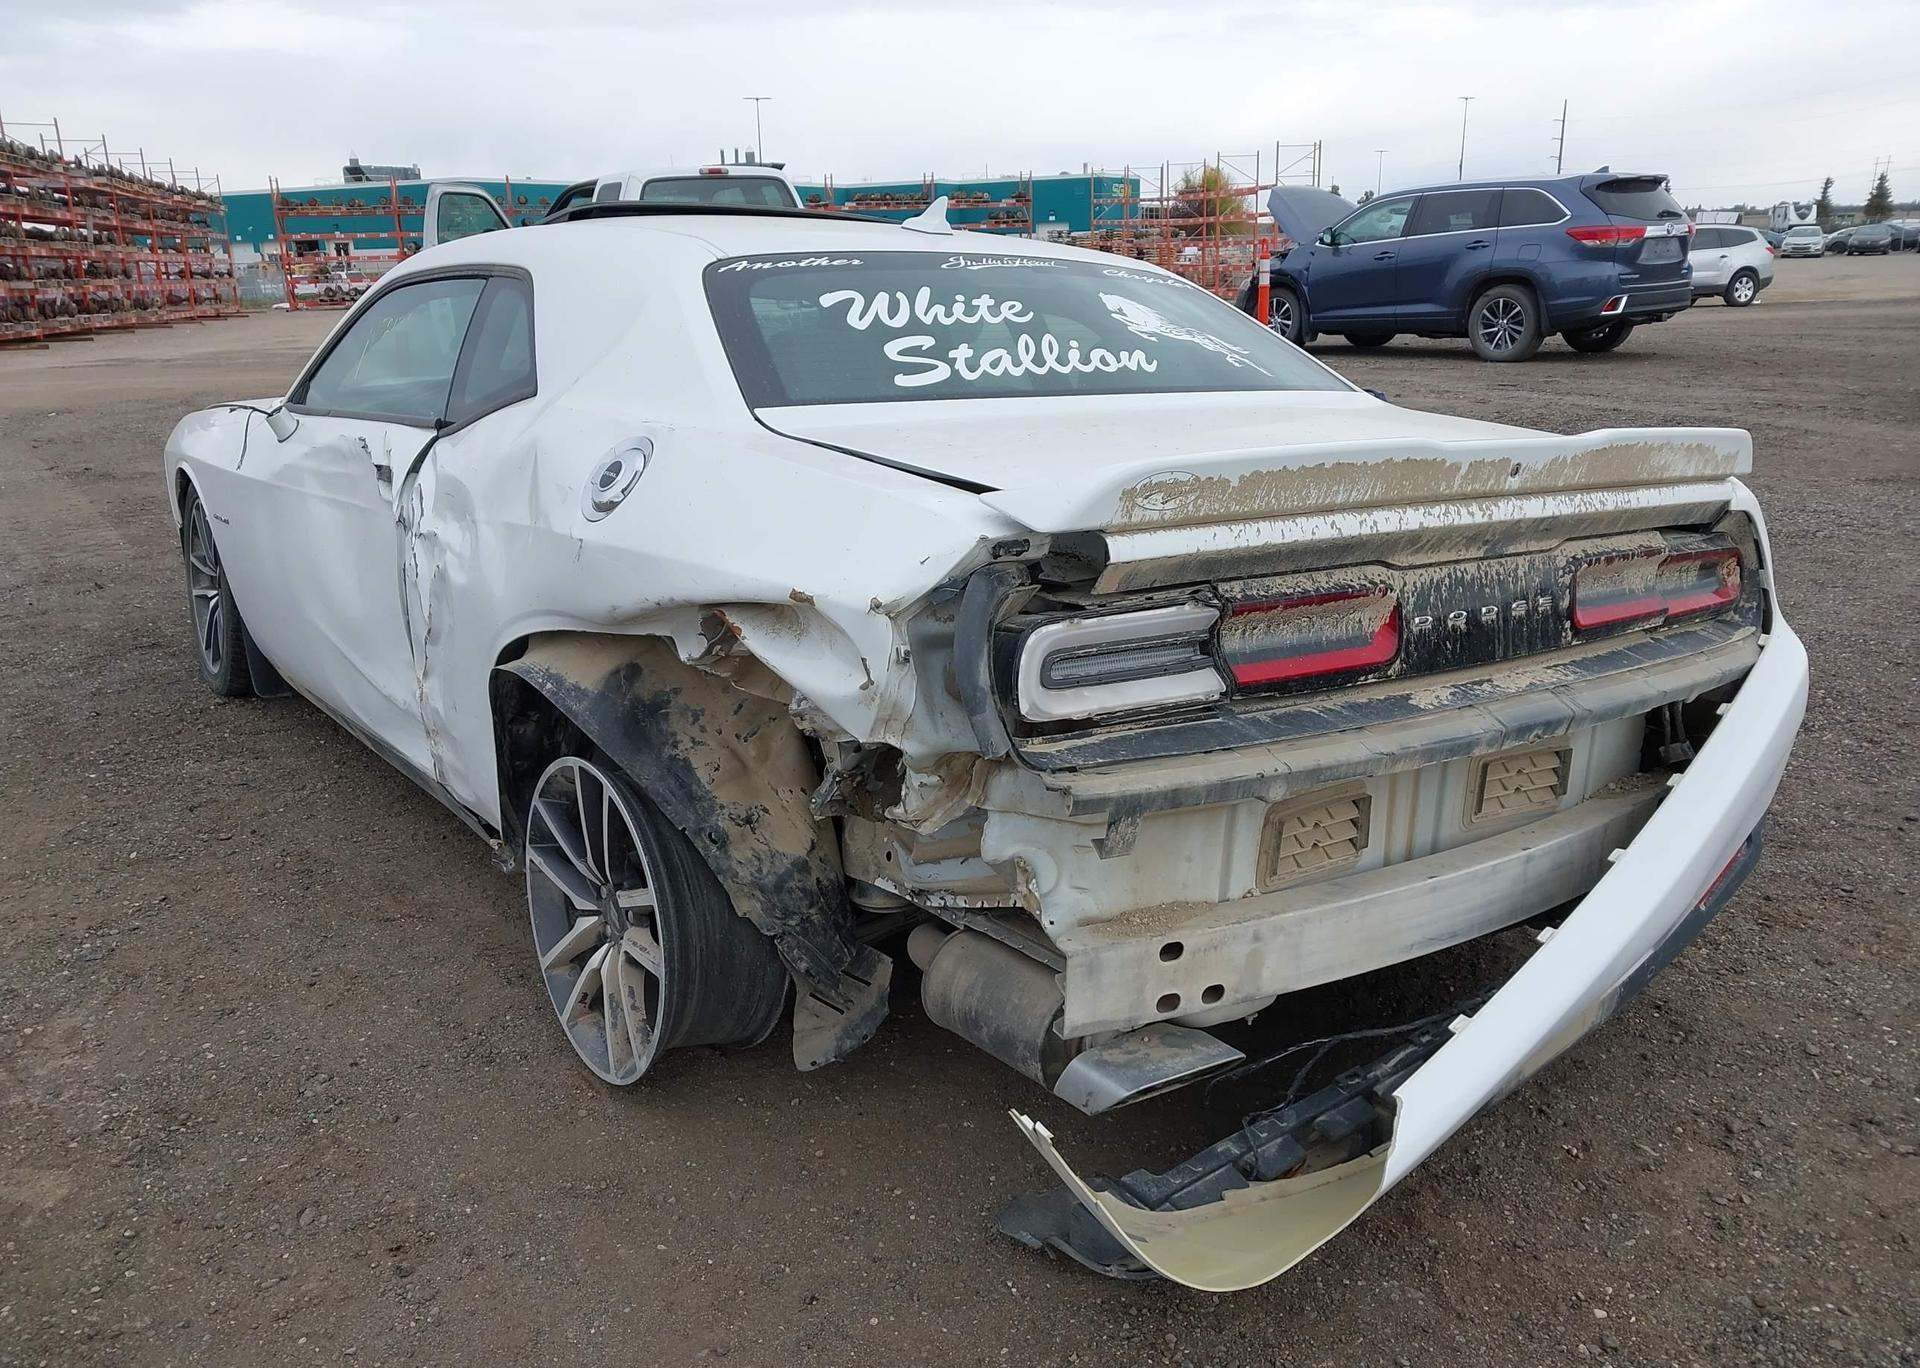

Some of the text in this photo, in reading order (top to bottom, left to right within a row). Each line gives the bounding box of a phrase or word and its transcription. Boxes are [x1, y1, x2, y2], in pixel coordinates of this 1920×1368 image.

[718, 257, 865, 273] Another
[819, 286, 1034, 331] White
[884, 334, 1158, 387] Stallion
[1414, 597, 1553, 629] DODGE
